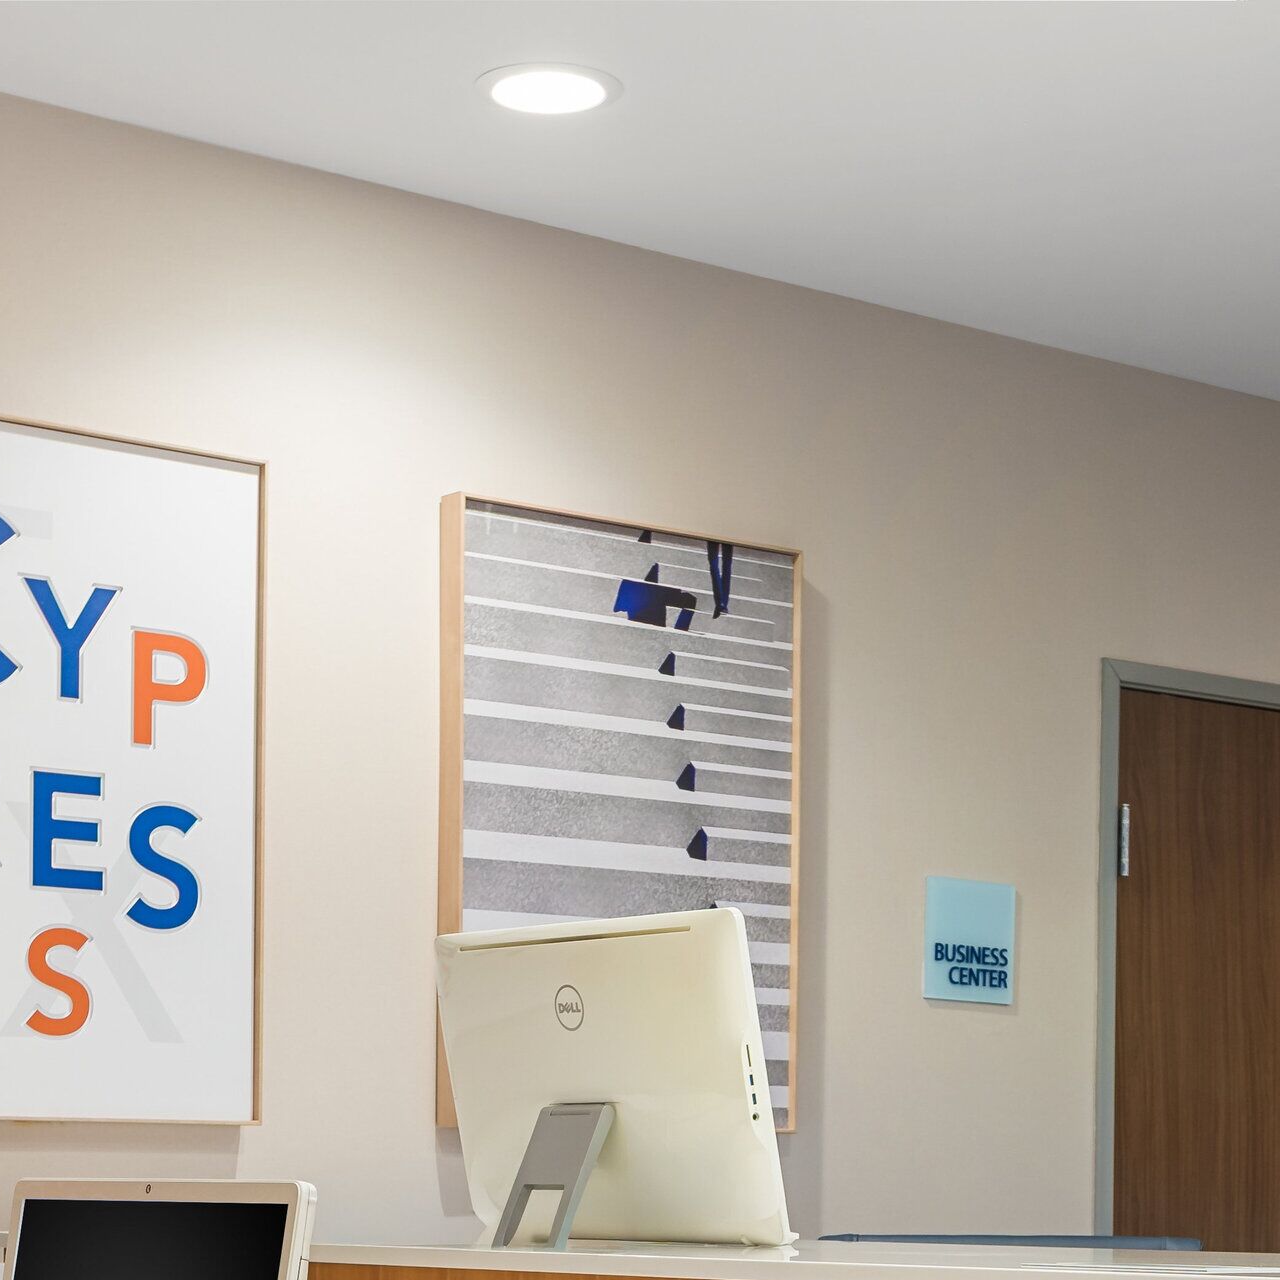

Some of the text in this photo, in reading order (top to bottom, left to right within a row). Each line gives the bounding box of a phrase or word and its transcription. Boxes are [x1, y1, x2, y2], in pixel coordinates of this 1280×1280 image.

[934, 942, 1008, 967] BUSINESS
[948, 966, 1008, 989] CENTER
[558, 1002, 581, 1013] DELL
